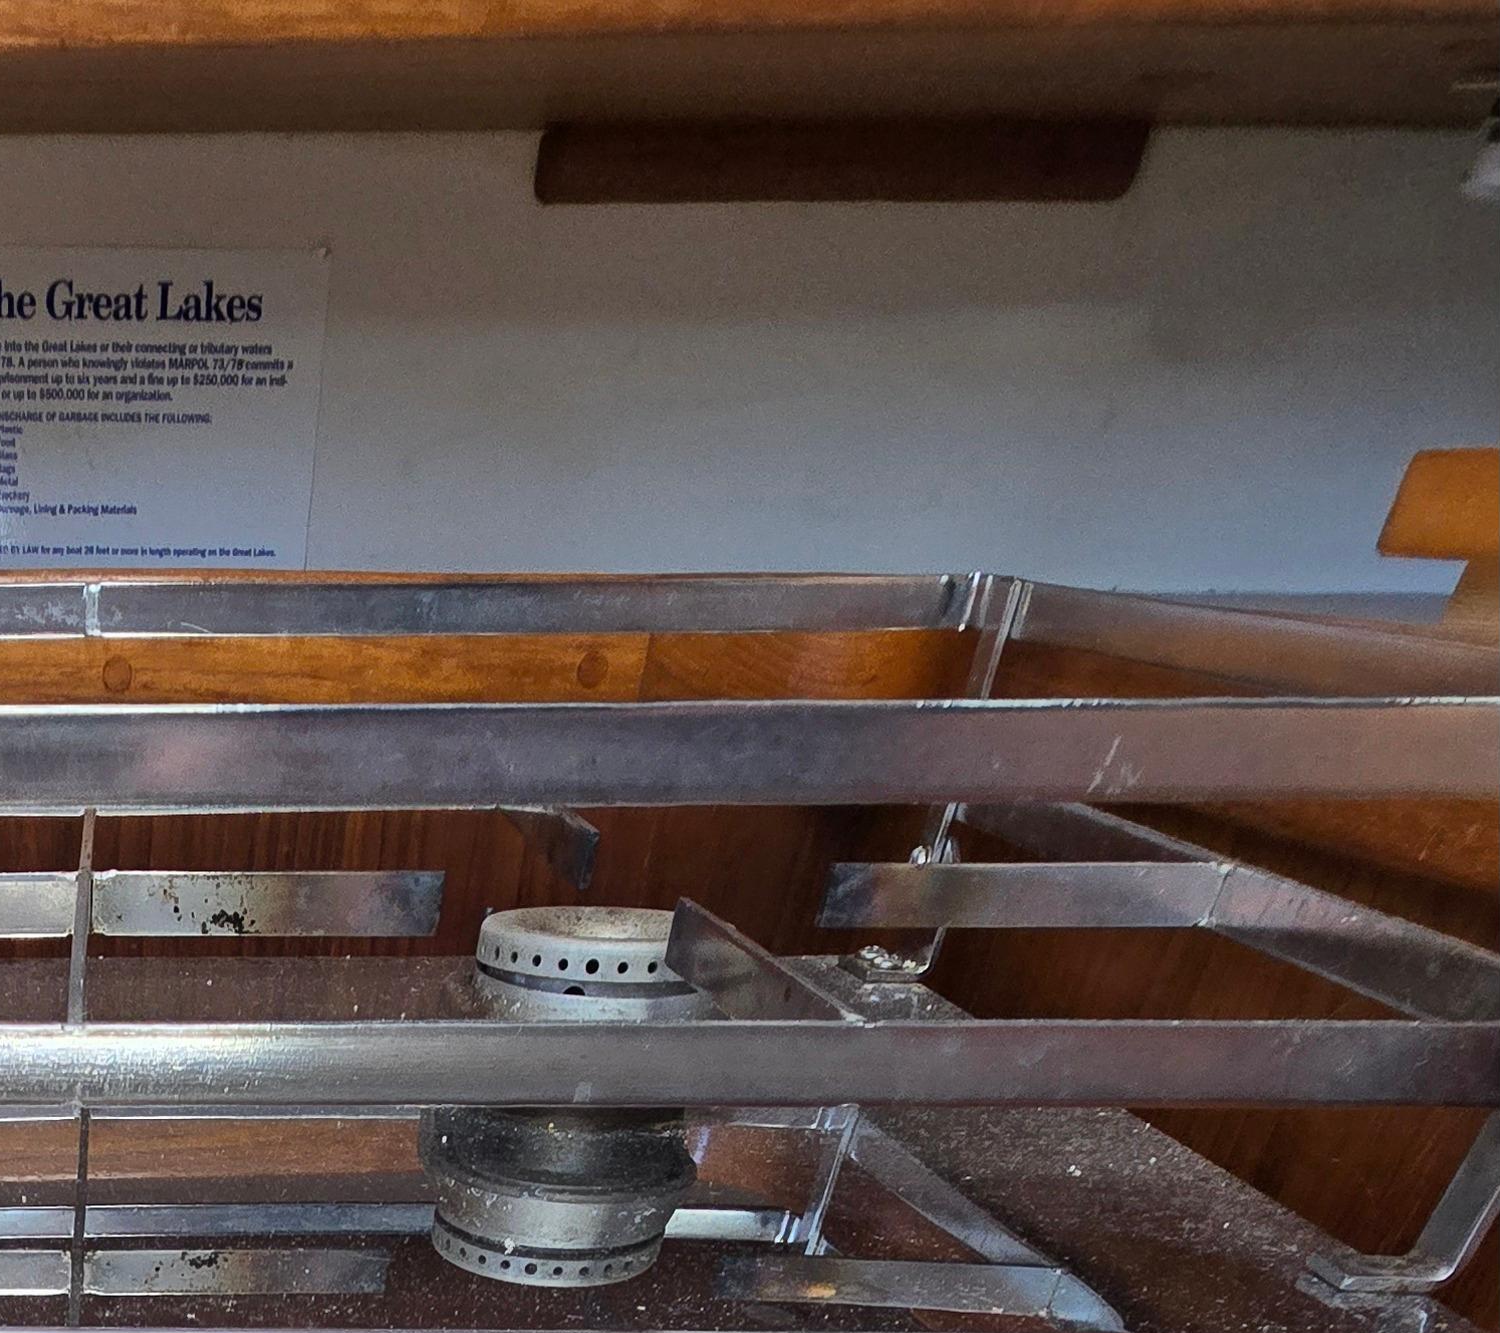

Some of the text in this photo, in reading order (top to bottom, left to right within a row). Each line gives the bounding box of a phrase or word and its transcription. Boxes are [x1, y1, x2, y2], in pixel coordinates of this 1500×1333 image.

[46, 277, 148, 322] Great
[156, 279, 263, 323] Lakes
[4, 340, 22, 352] into
[24, 340, 39, 352] the
[42, 340, 67, 352] Great
[70, 340, 97, 353] Lakes
[100, 343, 110, 352] or
[112, 341, 132, 353] their
[134, 341, 186, 356] connecting
[188, 344, 198, 354] or
[200, 342, 239, 356] tributary
[241, 344, 272, 355] waters
[18, 356, 25, 367] A
[27, 357, 59, 369] person
[60, 357, 80, 369] who
[82, 357, 128, 372] knowingly
[130, 358, 165, 370] violates
[168, 358, 209, 371] MARPOL
[245, 359, 285, 371] commits
[51, 374, 63, 386] up
[65, 374, 75, 385] to
[77, 373, 90, 385] six
[93, 375, 118, 387] years
[120, 374, 137, 386] and
[139, 376, 145, 386] a
[147, 373, 164, 386] fine
[166, 376, 178, 388] up
[181, 374, 190, 386] to
[193, 374, 239, 387] $250,000
[241, 375, 254, 387] for
[255, 377, 267, 387] an
[1, 390, 11, 401] or
[13, 390, 25, 402] up
[27, 388, 37, 401] to
[87, 388, 100, 401] for
[102, 391, 113, 401] an
[115, 388, 173, 404] organization.
[45, 411, 56, 422] OF
[58, 411, 99, 423] GARBAGE
[100, 411, 142, 423] INCLUDES
[144, 412, 160, 424] THE
[162, 412, 212, 425] FOLLOWING:
[34, 504, 57, 516] Lining
[59, 504, 65, 515] &
[67, 504, 99, 517] Packing
[100, 504, 137, 516] Materials
[22, 545, 39, 555] LAW
[41, 545, 50, 554] for
[149, 547, 171, 558] length
[173, 547, 206, 558] operating
